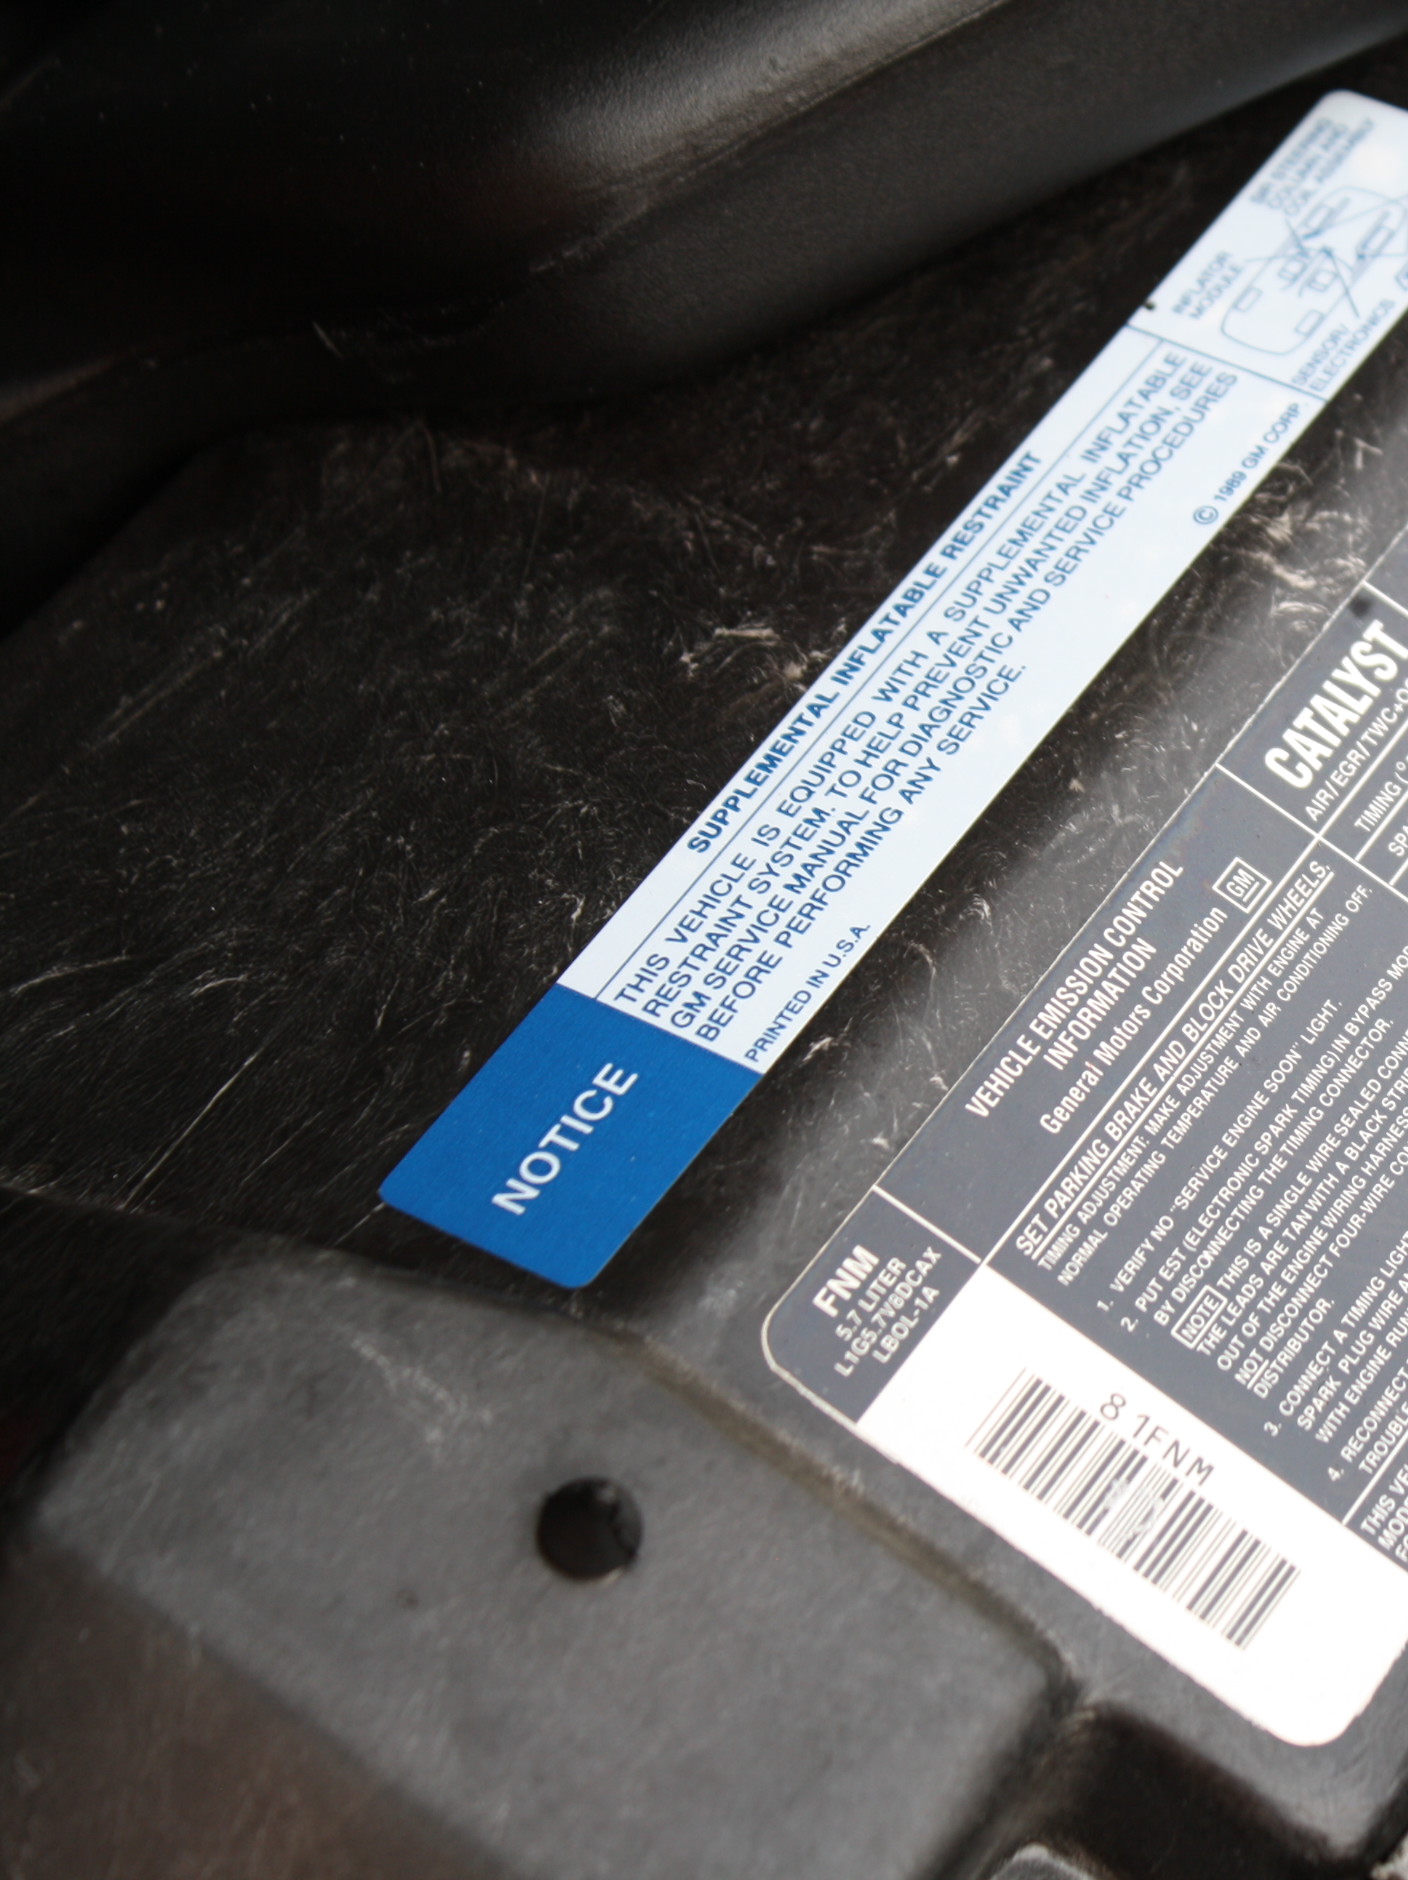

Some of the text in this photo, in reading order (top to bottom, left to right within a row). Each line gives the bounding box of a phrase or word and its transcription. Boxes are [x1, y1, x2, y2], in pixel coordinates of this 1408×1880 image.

[1212, 469, 1247, 502] 1989
[1240, 443, 1267, 469] GM
[612, 352, 1186, 1003] THIS VEHICLE IS EQUIPPED WITH A SUPPLEMENTAL INFLATABLE
[640, 362, 1212, 1018] RESTRAINT SYSTEM. TO HELP PREVENT UNWANTED INFLATION, SEE
[669, 371, 1238, 1029] GM SERVICE MANUAL FOR DIAGNOSTIC AND SERVICE PROCEDURES
[686, 450, 1040, 854] SUPPLEMENTAL INFLATABLE RESTRAINT
[694, 663, 1026, 1042] BEFORE PERFORMING ANY SERVICE.
[1225, 867, 1257, 900] GM
[743, 924, 871, 1063] PRINTED IN U.S.A.
[963, 860, 1184, 1117] VEHICLE EMISSION CONTROL
[1014, 859, 1332, 1256] SET PARKING BRAKE AND BLOCK DRIVE WHEELS.
[1036, 906, 1324, 1271] TIMING ADJUSTMENT: MAKE ADJUSTMENT WITH ENGINE AT
[1038, 906, 1228, 1134] General Motors Corporation
[1041, 936, 1157, 1070] INFORMATION
[491, 1061, 638, 1215] NOTICE
[1095, 1299, 1114, 1312] 1.
[1108, 1236, 1155, 1292] VERIFY
[1149, 1214, 1174, 1242] NO
[1220, 1089, 1270, 1148] ENGINE
[1299, 997, 1343, 1045] LIGHT.
[811, 1244, 879, 1317] FNM
[834, 1256, 906, 1341] 5.7 LITER
[1359, 1493, 1400, 1538] THIS
